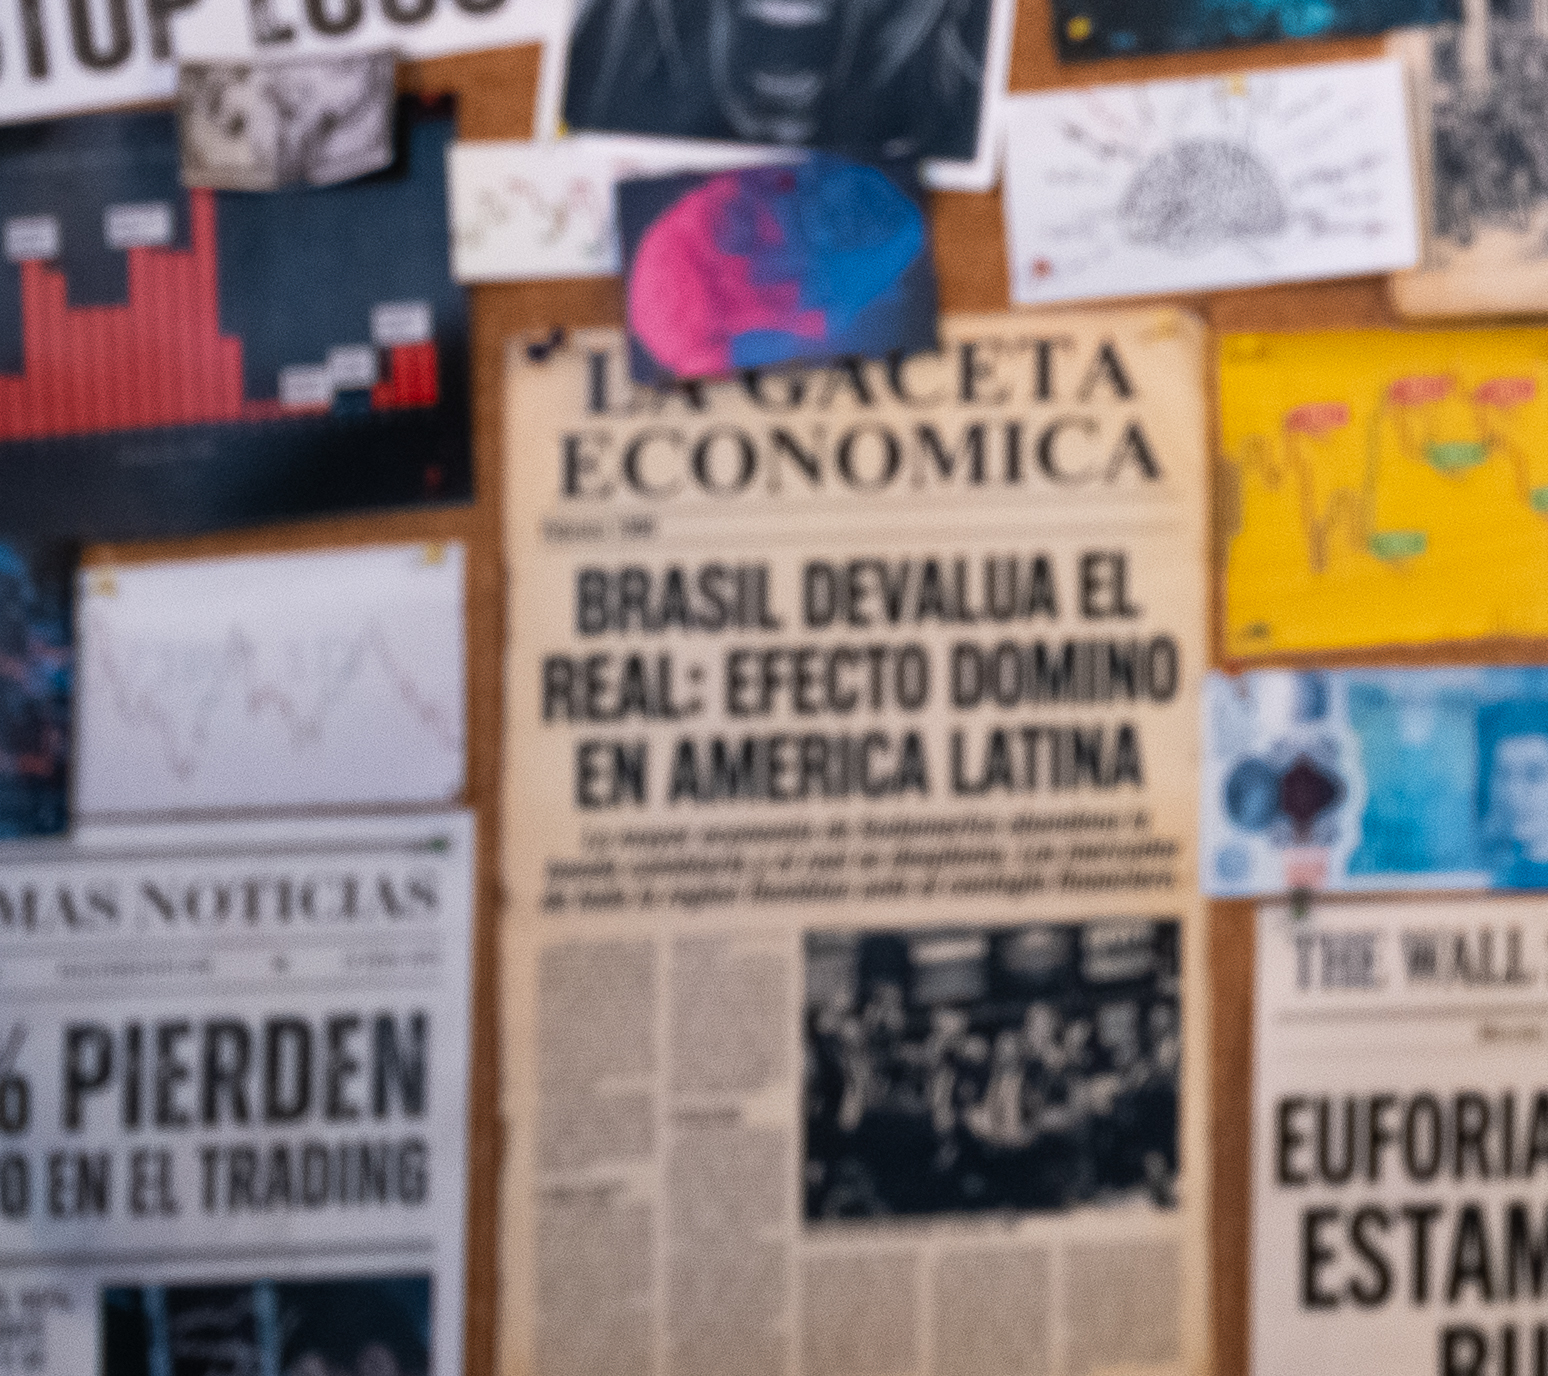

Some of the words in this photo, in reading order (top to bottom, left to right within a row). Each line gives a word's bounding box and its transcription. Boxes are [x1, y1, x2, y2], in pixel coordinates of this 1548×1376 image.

[557, 415, 1165, 500] ECONOMICA
[575, 560, 781, 638] BRASIL
[803, 552, 1059, 630] DEVALUA
[1078, 548, 1140, 619] EL
[542, 652, 706, 726] REAL:
[726, 643, 929, 718] EFECTO
[950, 635, 1180, 711] DOMINO
[575, 738, 649, 809] EN
[668, 726, 930, 806] AMERICA
[950, 723, 1145, 795] LATINA
[134, 869, 442, 929] NOTICIAS
[1291, 929, 1384, 992] THE
[1400, 923, 1533, 988] WALL
[61, 1010, 430, 1134] PIERDEN
[46, 1148, 111, 1220] EN
[129, 1144, 180, 1215] EL
[196, 1138, 430, 1211] TRADING
